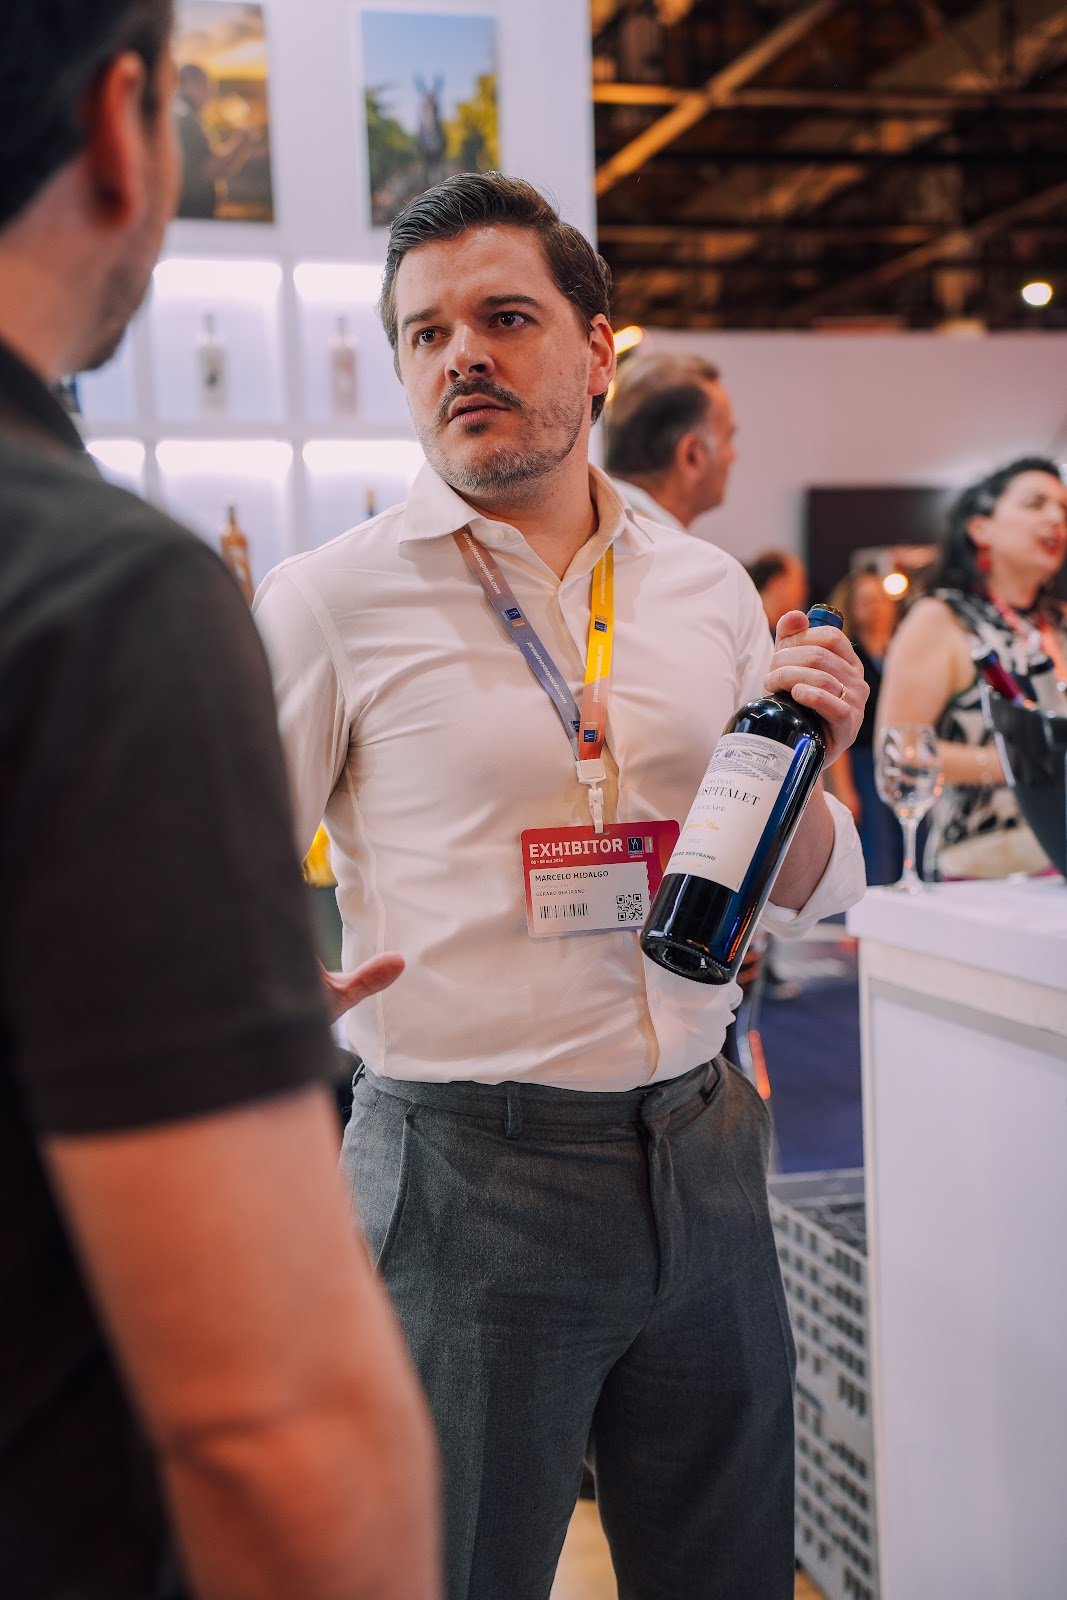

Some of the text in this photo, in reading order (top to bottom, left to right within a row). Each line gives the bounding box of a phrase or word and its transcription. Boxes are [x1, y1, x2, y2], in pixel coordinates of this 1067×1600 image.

[697, 786, 761, 806] OSPITALET
[528, 838, 624, 858] EXHIBITOR
[535, 870, 609, 882] MARCELO HIDALGO
